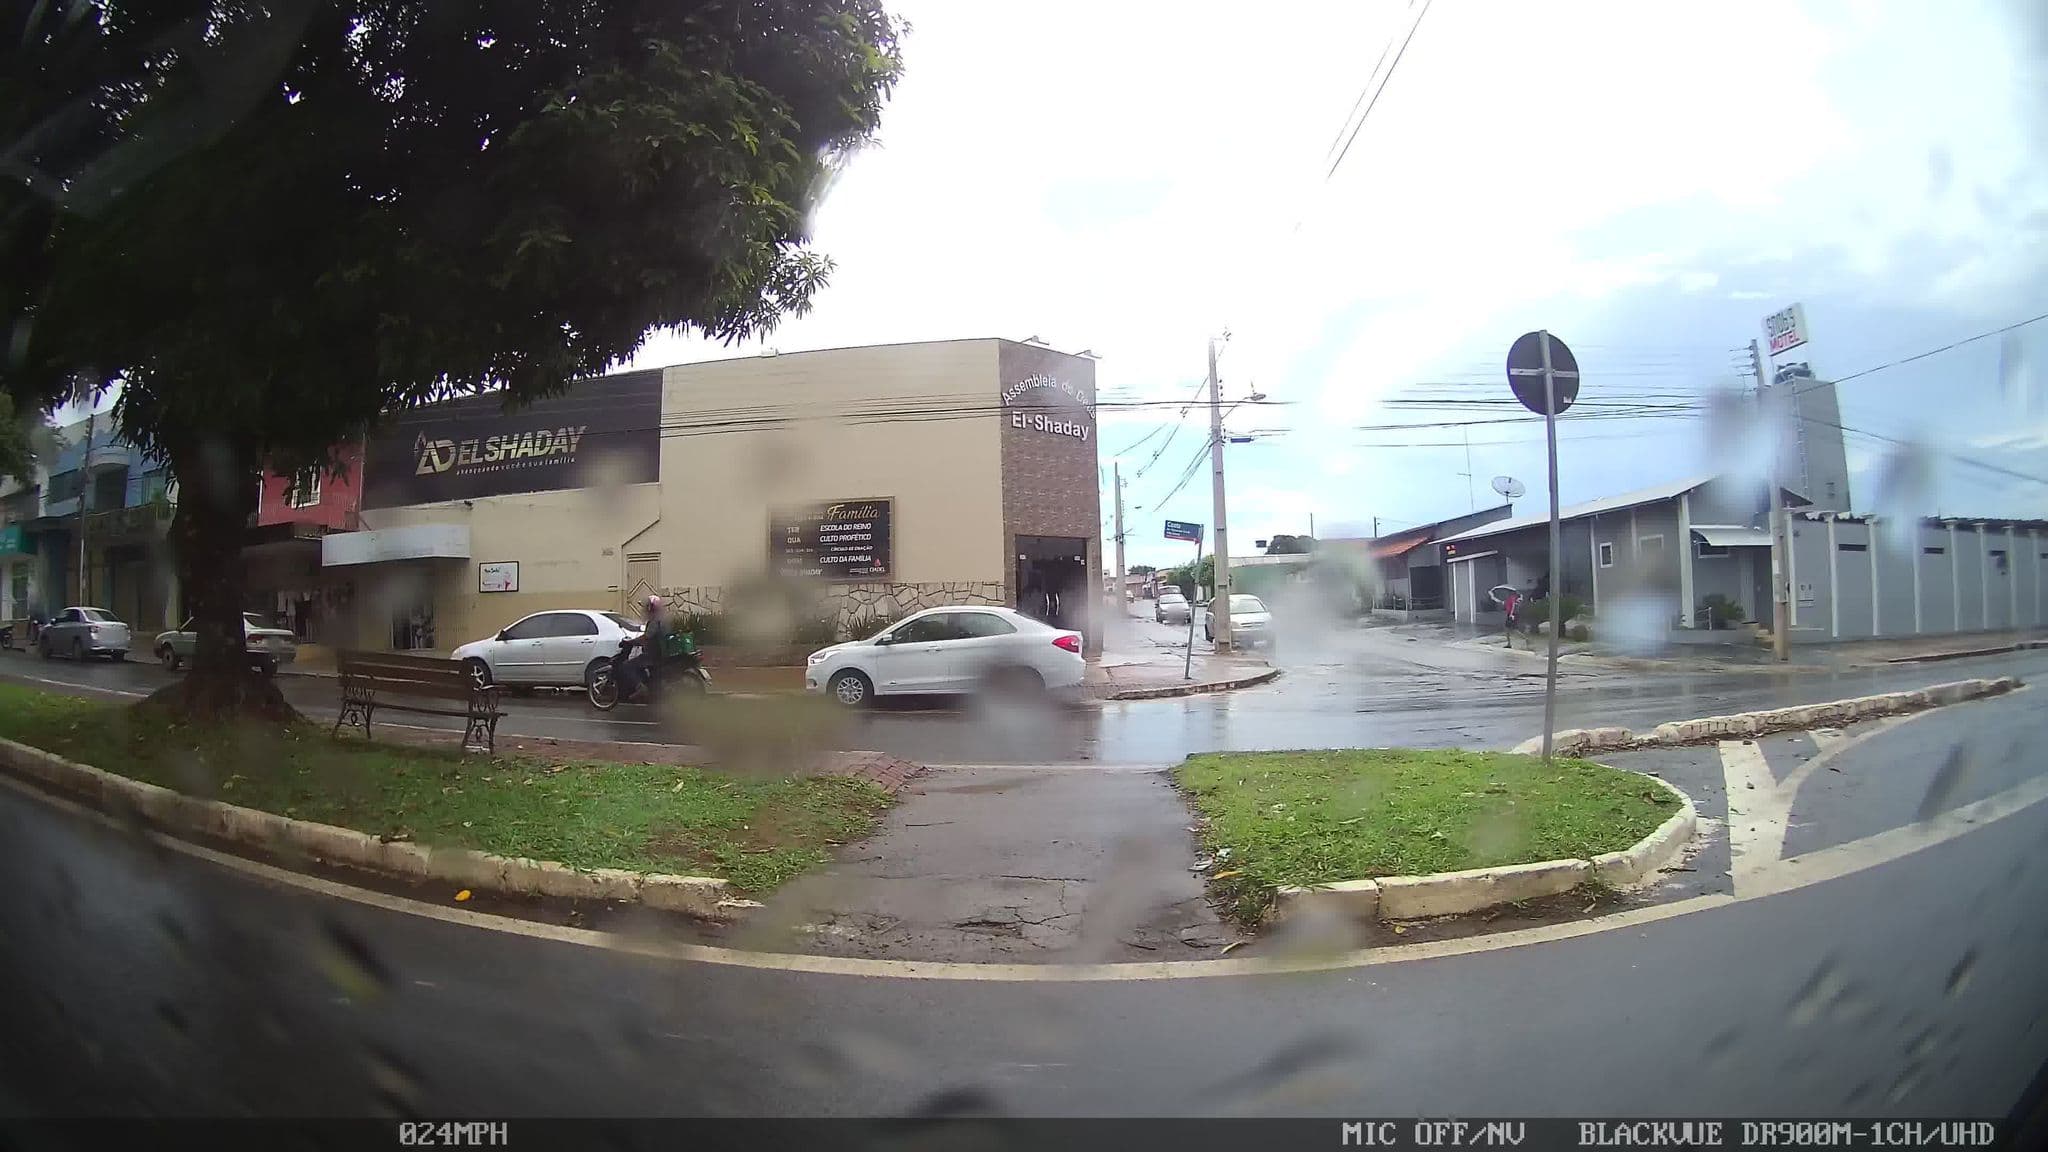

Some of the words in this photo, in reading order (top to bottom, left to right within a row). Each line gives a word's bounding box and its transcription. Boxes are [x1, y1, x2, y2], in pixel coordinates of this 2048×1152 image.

[1769, 331, 1800, 350] MOTEL
[1002, 373, 1057, 406] Assembleia
[820, 524, 843, 532] ESCOLA
[843, 523, 852, 531] DO
[852, 522, 872, 530] REINO
[820, 534, 838, 543] CULTO
[820, 556, 838, 564] CULTO
[838, 555, 848, 563] DA
